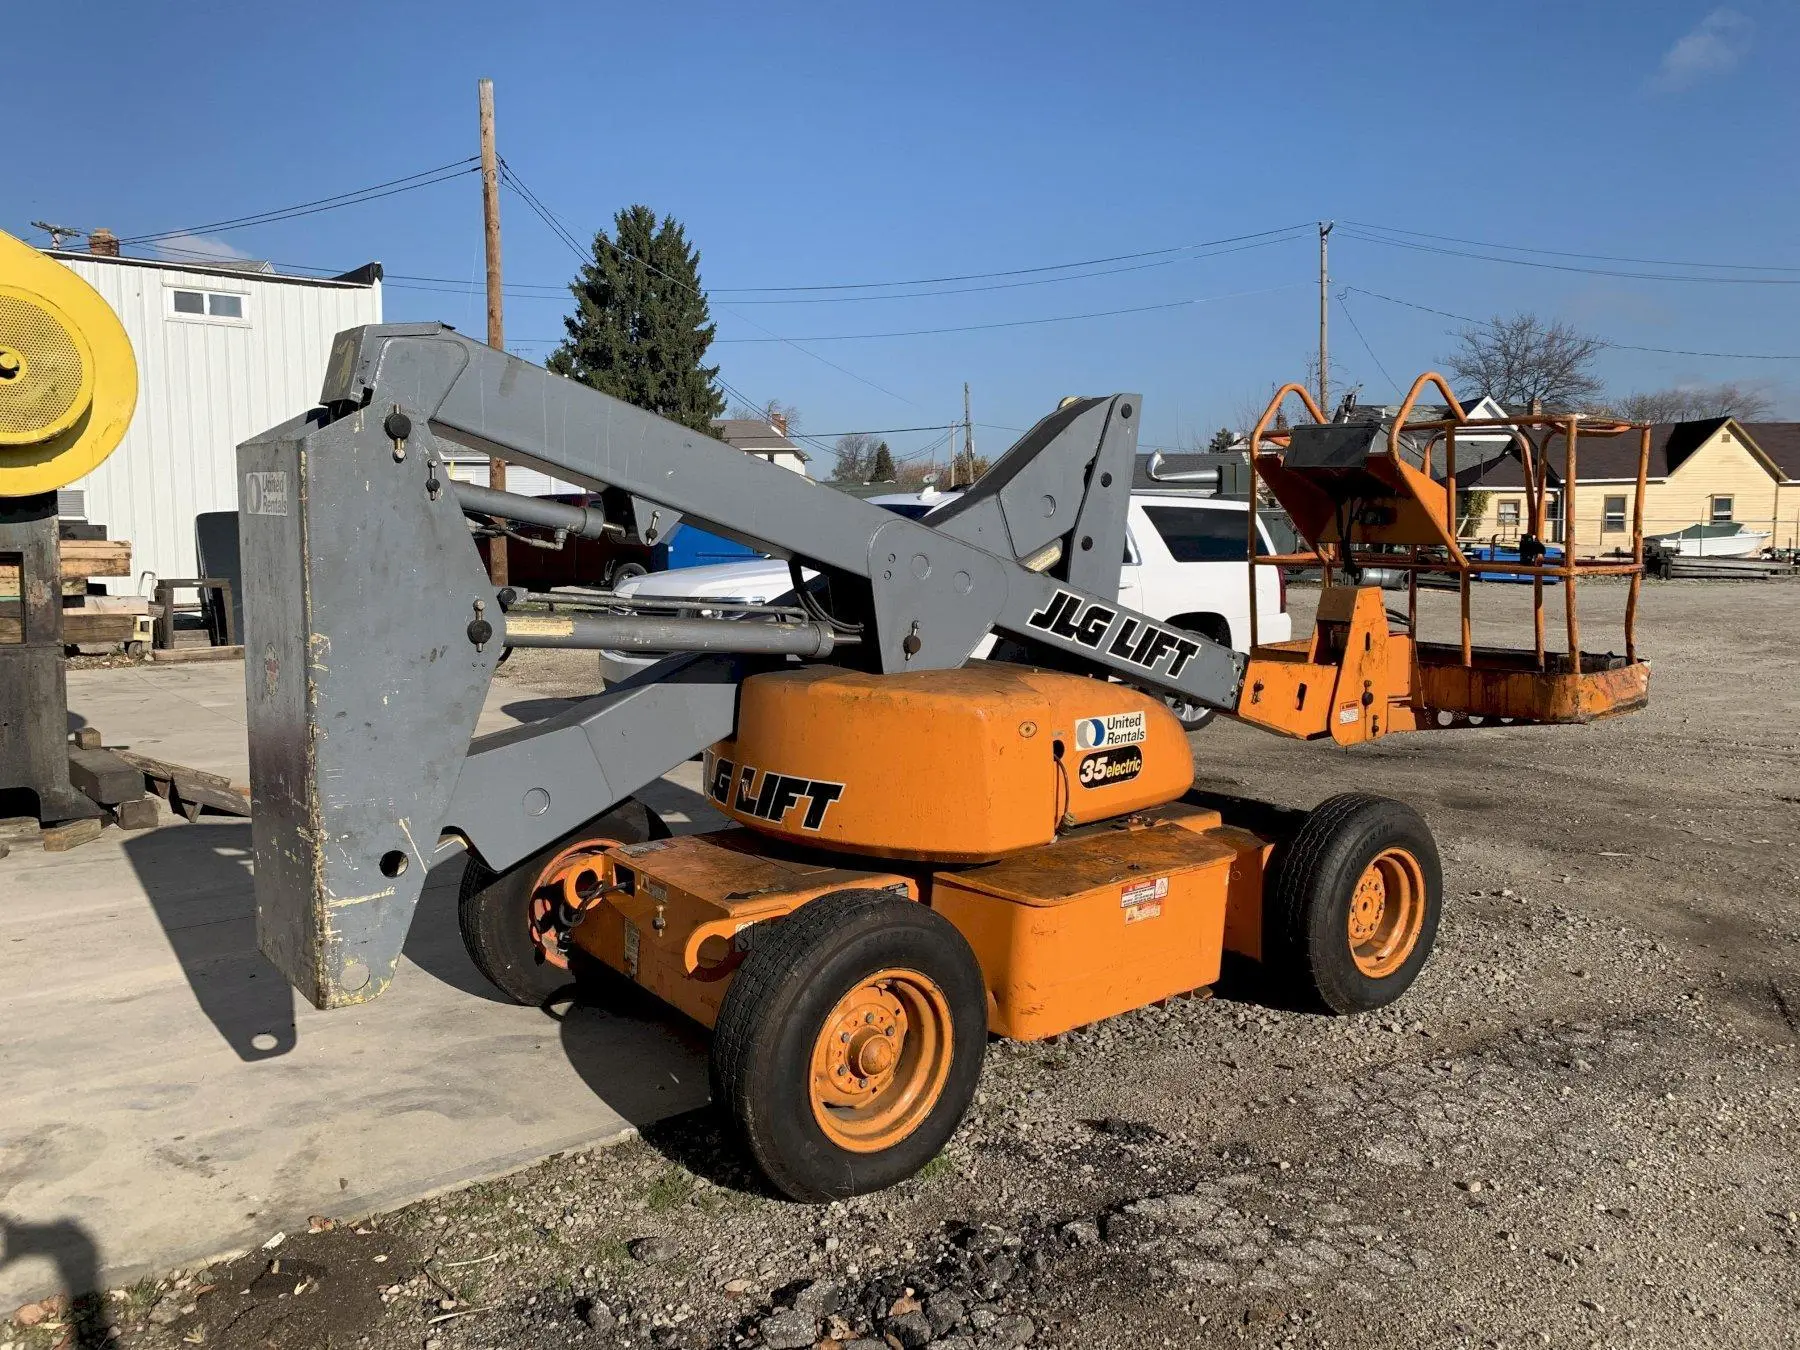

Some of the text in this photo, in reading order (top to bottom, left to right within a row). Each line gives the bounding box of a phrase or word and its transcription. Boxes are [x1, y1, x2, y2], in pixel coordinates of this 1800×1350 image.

[262, 474, 284, 493] United
[263, 495, 288, 514] Rentals
[1026, 589, 1201, 679] JLG LIFT
[1106, 713, 1142, 730] United
[1106, 728, 1145, 745] Rentals
[1080, 756, 1141, 783] 35 electric
[734, 765, 846, 831] LIFT
